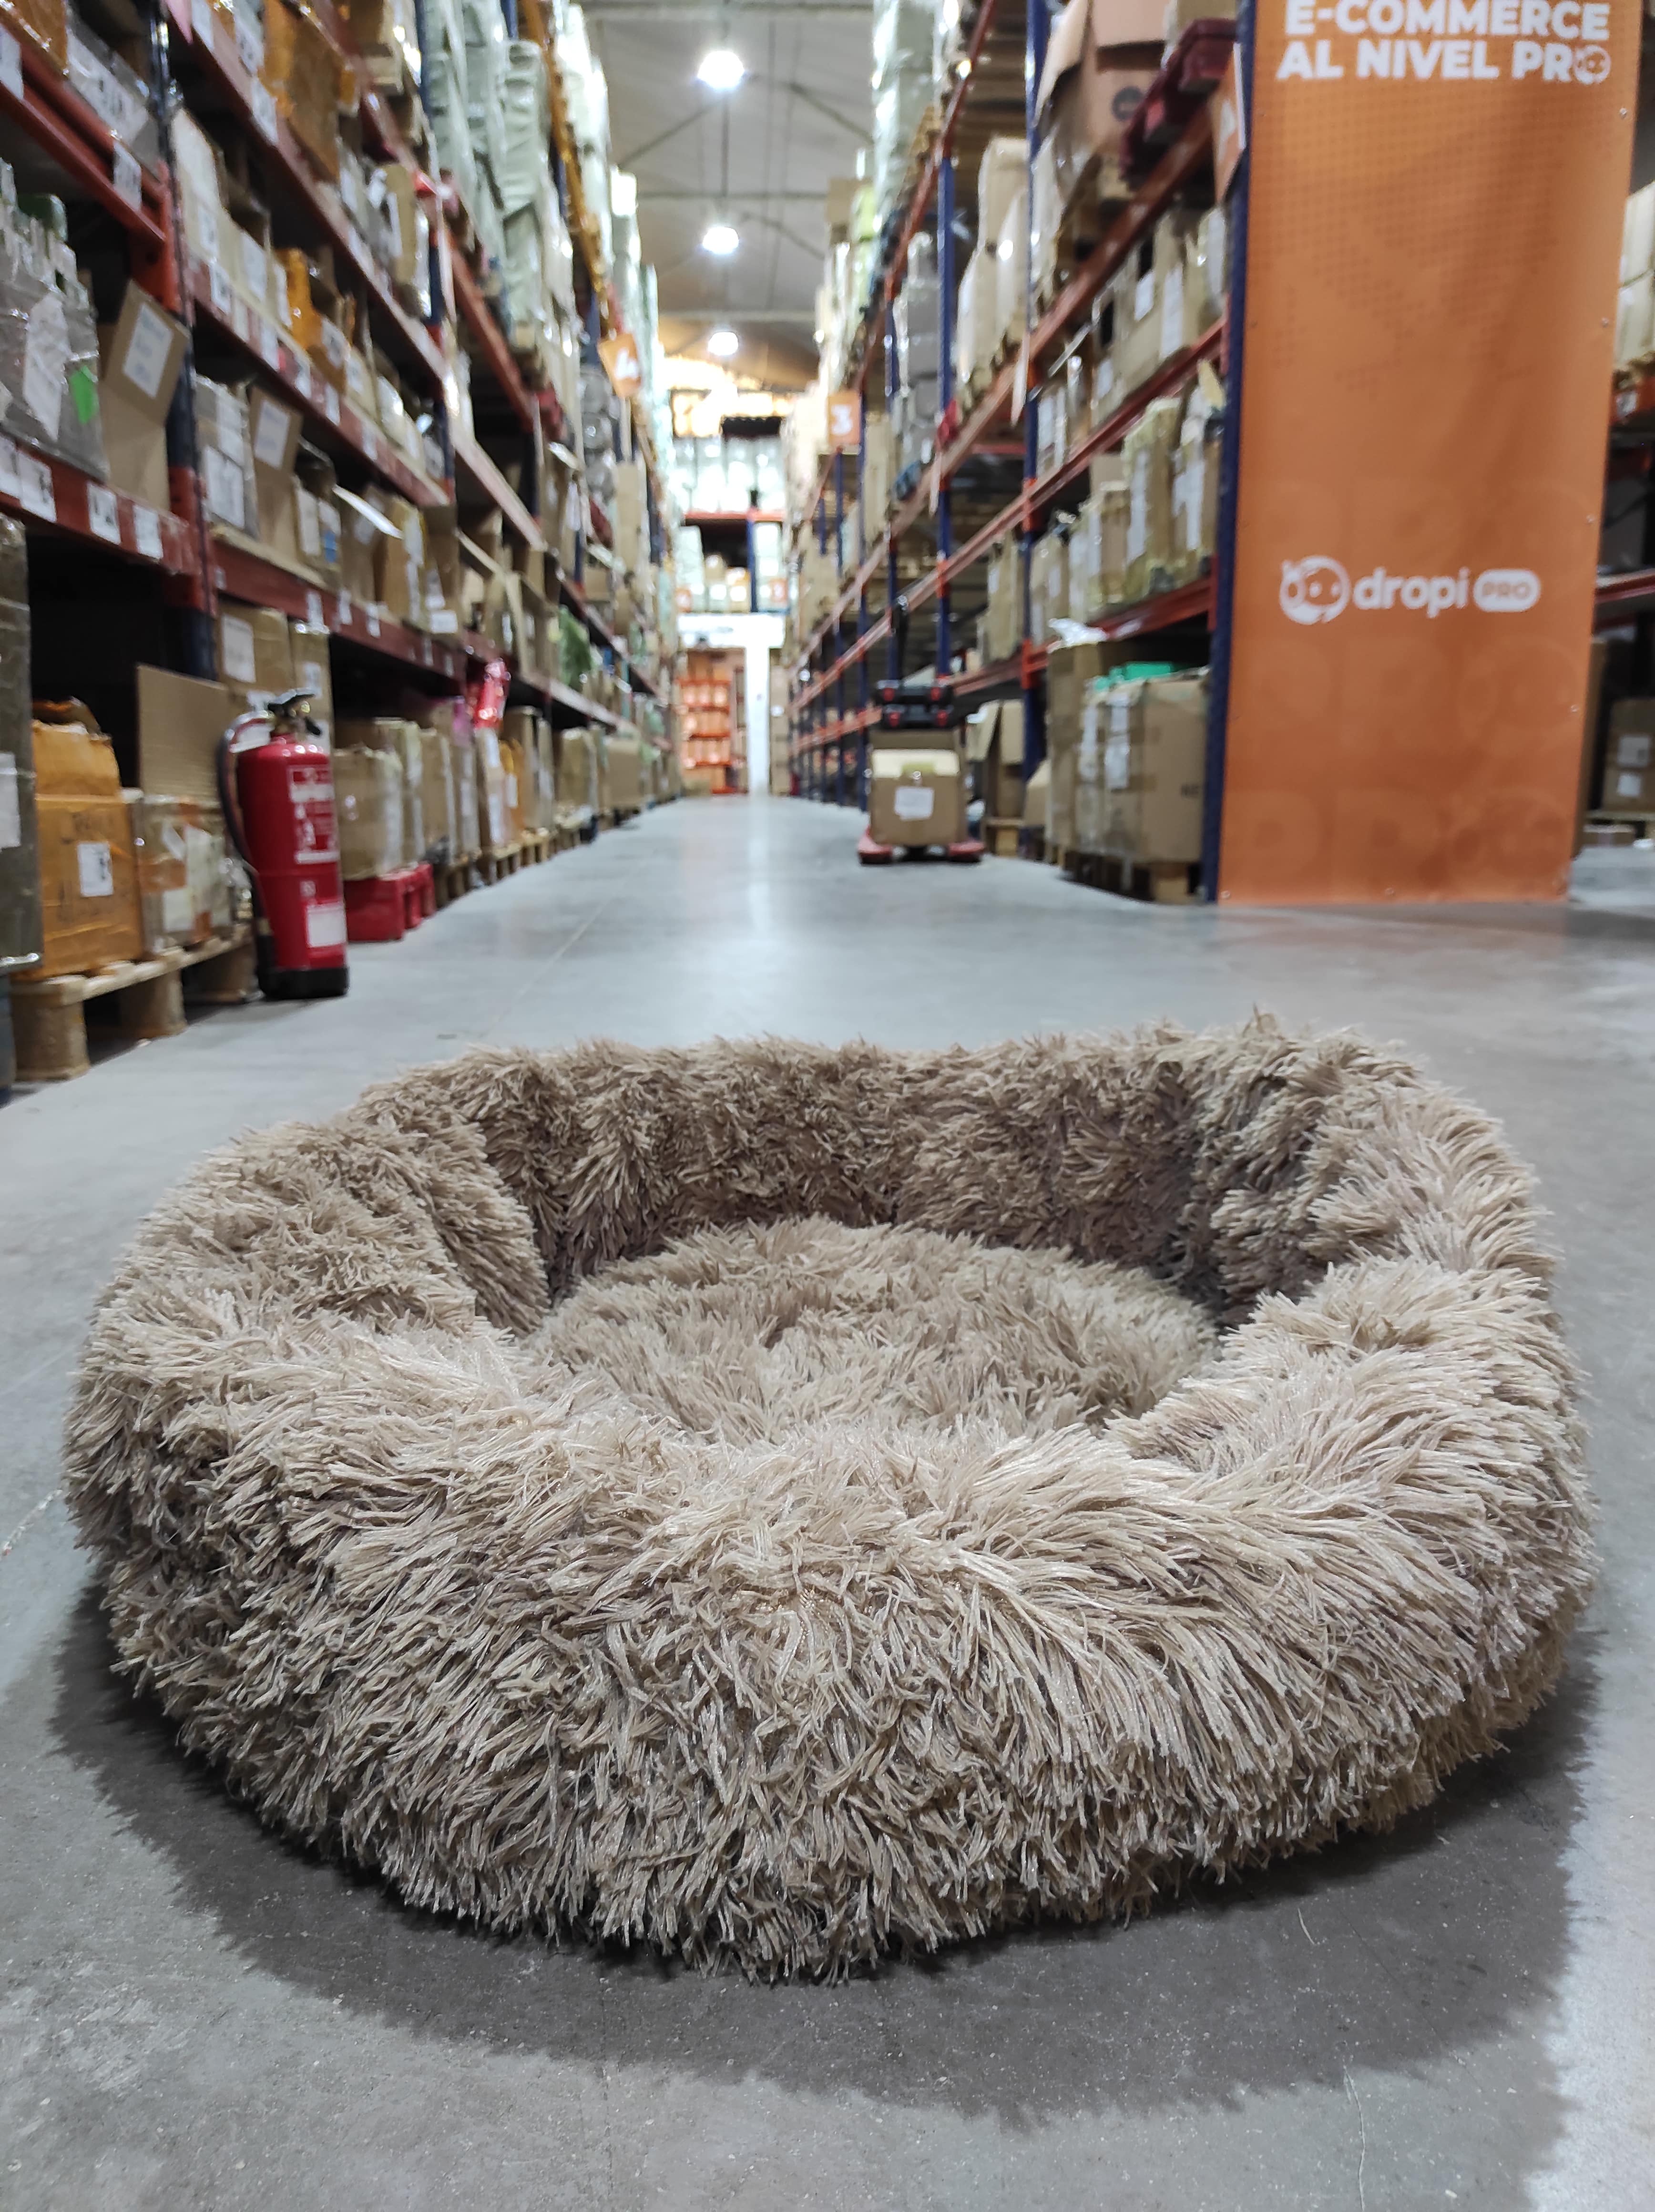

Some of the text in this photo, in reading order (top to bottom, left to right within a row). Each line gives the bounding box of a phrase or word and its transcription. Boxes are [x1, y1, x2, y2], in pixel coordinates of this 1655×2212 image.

[1286, 0, 1610, 40] E-COMMERCE
[1275, 39, 1344, 80] AL
[1356, 39, 1500, 80] NIVEL
[831, 404, 853, 435] 3
[1353, 566, 1531, 619] dropi PRO
